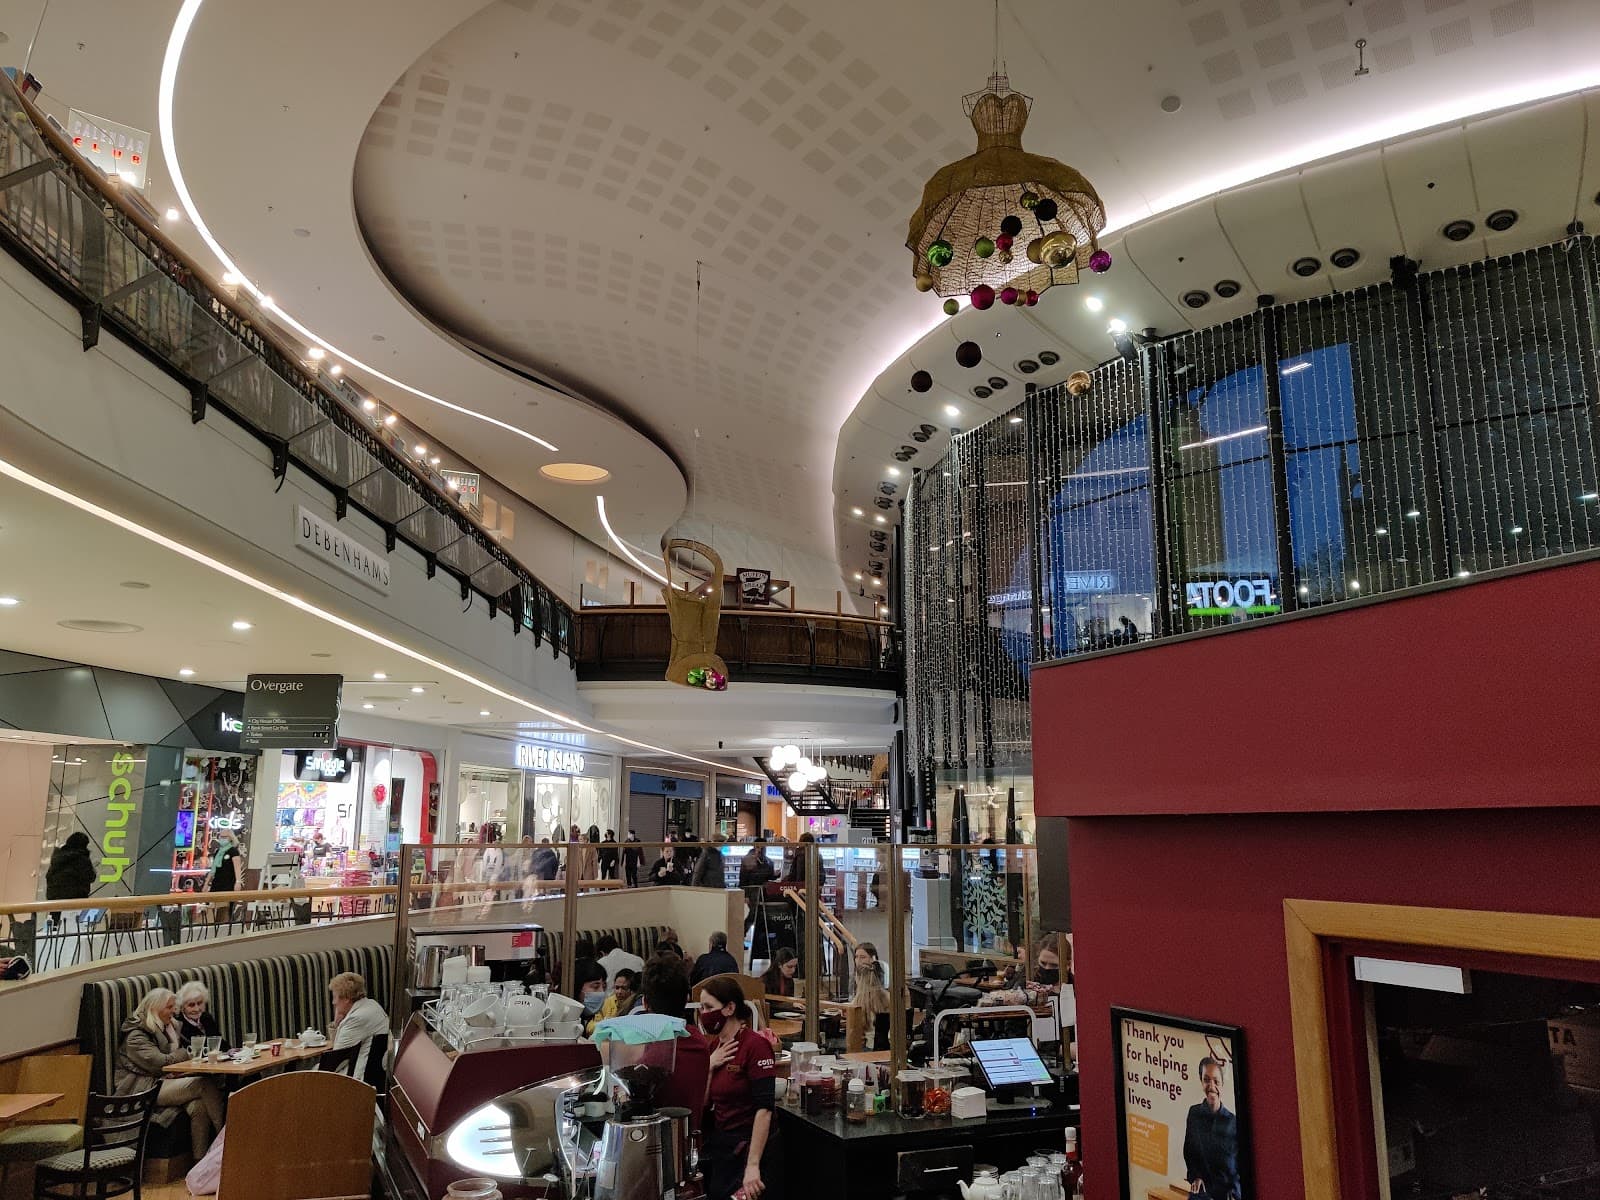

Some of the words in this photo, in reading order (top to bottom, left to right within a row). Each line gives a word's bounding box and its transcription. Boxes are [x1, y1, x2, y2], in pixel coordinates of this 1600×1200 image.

[302, 516, 389, 586] DEBENHAMS
[250, 679, 304, 694] Overgate
[519, 744, 549, 769] RIVER
[552, 749, 586, 773] ISLAND
[99, 751, 136, 883] schuh
[1124, 1020, 1160, 1043] Thank
[1163, 1034, 1185, 1052] you
[1126, 1043, 1142, 1062] for
[1145, 1047, 1189, 1081] helping
[1127, 1070, 1140, 1084] us
[1142, 1071, 1182, 1101] change
[1128, 1087, 1152, 1110] lives
